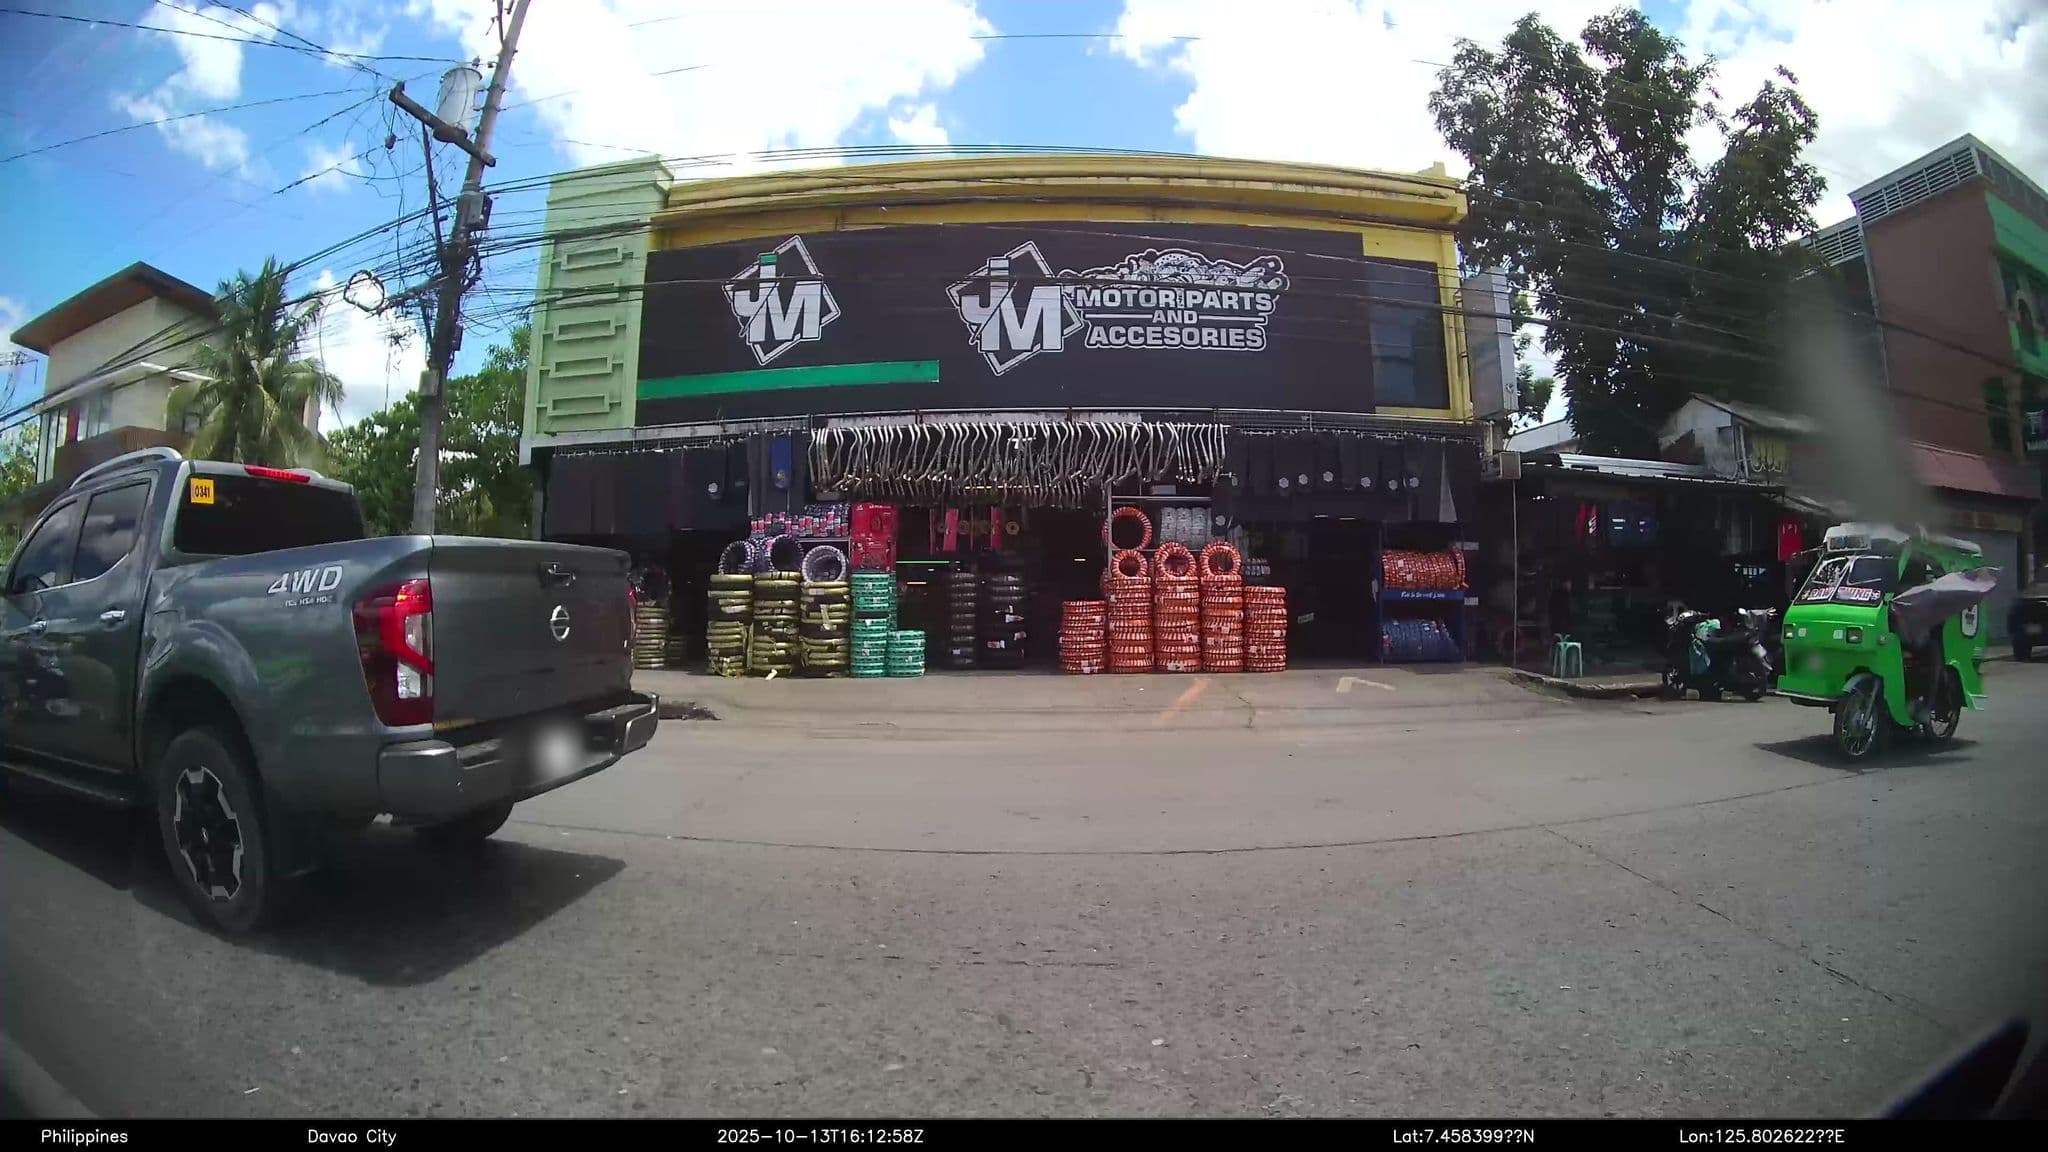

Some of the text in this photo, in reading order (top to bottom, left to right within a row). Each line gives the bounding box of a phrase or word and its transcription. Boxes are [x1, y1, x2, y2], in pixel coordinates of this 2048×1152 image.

[1076, 289, 1273, 312] MOTOR PARTS
[1152, 310, 1198, 324] AND
[1089, 326, 1264, 348] ACCESORIES
[268, 565, 343, 594] 4WD
